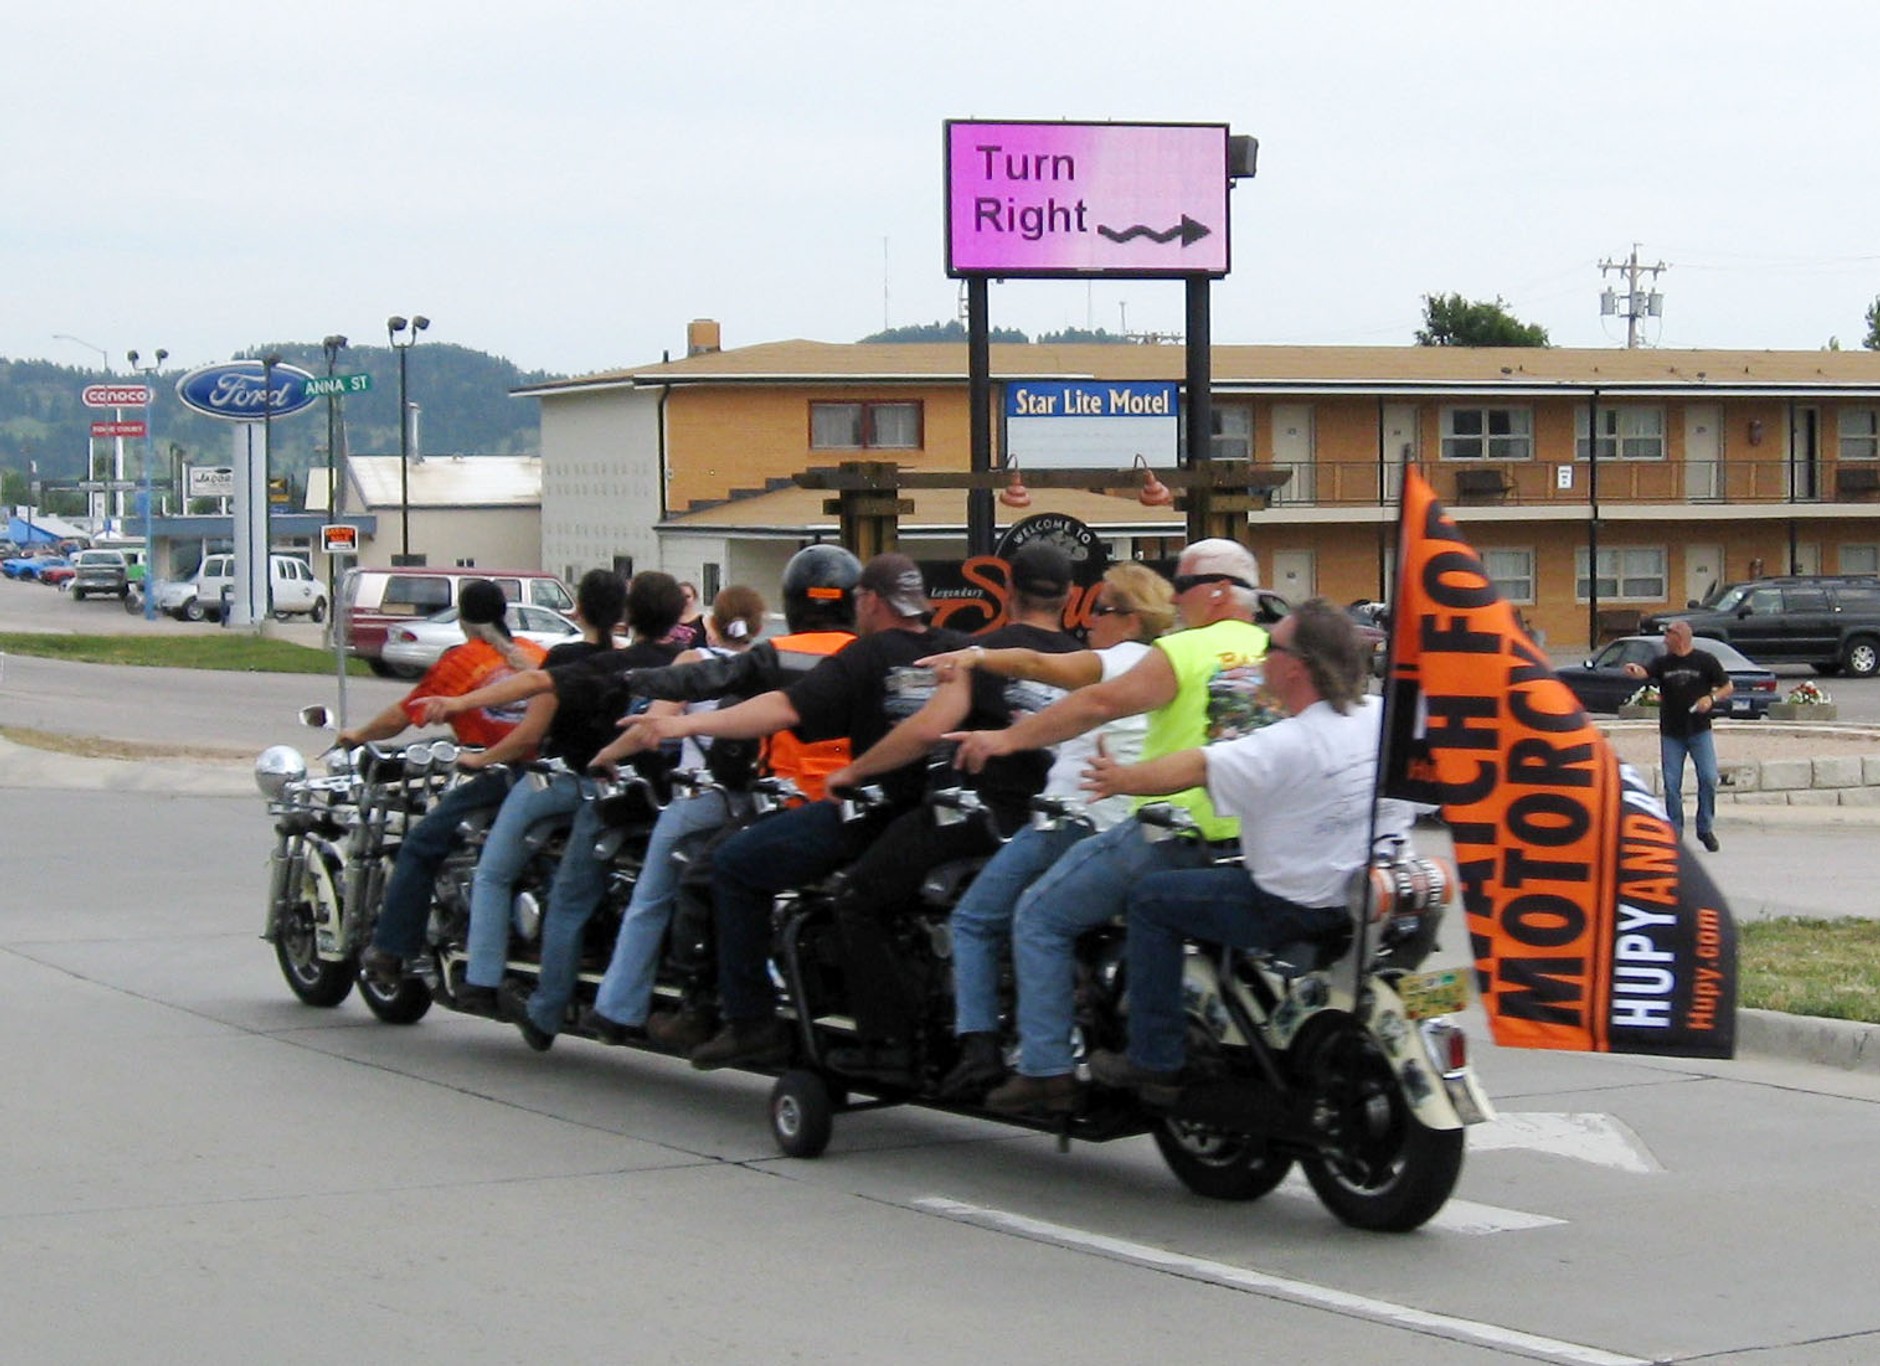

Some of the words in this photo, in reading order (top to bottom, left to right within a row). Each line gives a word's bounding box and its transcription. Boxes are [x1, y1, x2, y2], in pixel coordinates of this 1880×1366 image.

[975, 145, 1075, 181] Turn
[974, 197, 1088, 241] Right
[208, 372, 292, 407] Ford
[305, 378, 345, 396] ANNA
[350, 374, 368, 391] ST
[1015, 388, 1057, 415] Star
[1063, 388, 1102, 415] Lite
[1108, 388, 1169, 415] Motel
[1013, 518, 1071, 544] WELCOME
[1076, 527, 1091, 544] TO
[930, 586, 984, 599] Legendary
[1425, 694, 1498, 994] ACH
